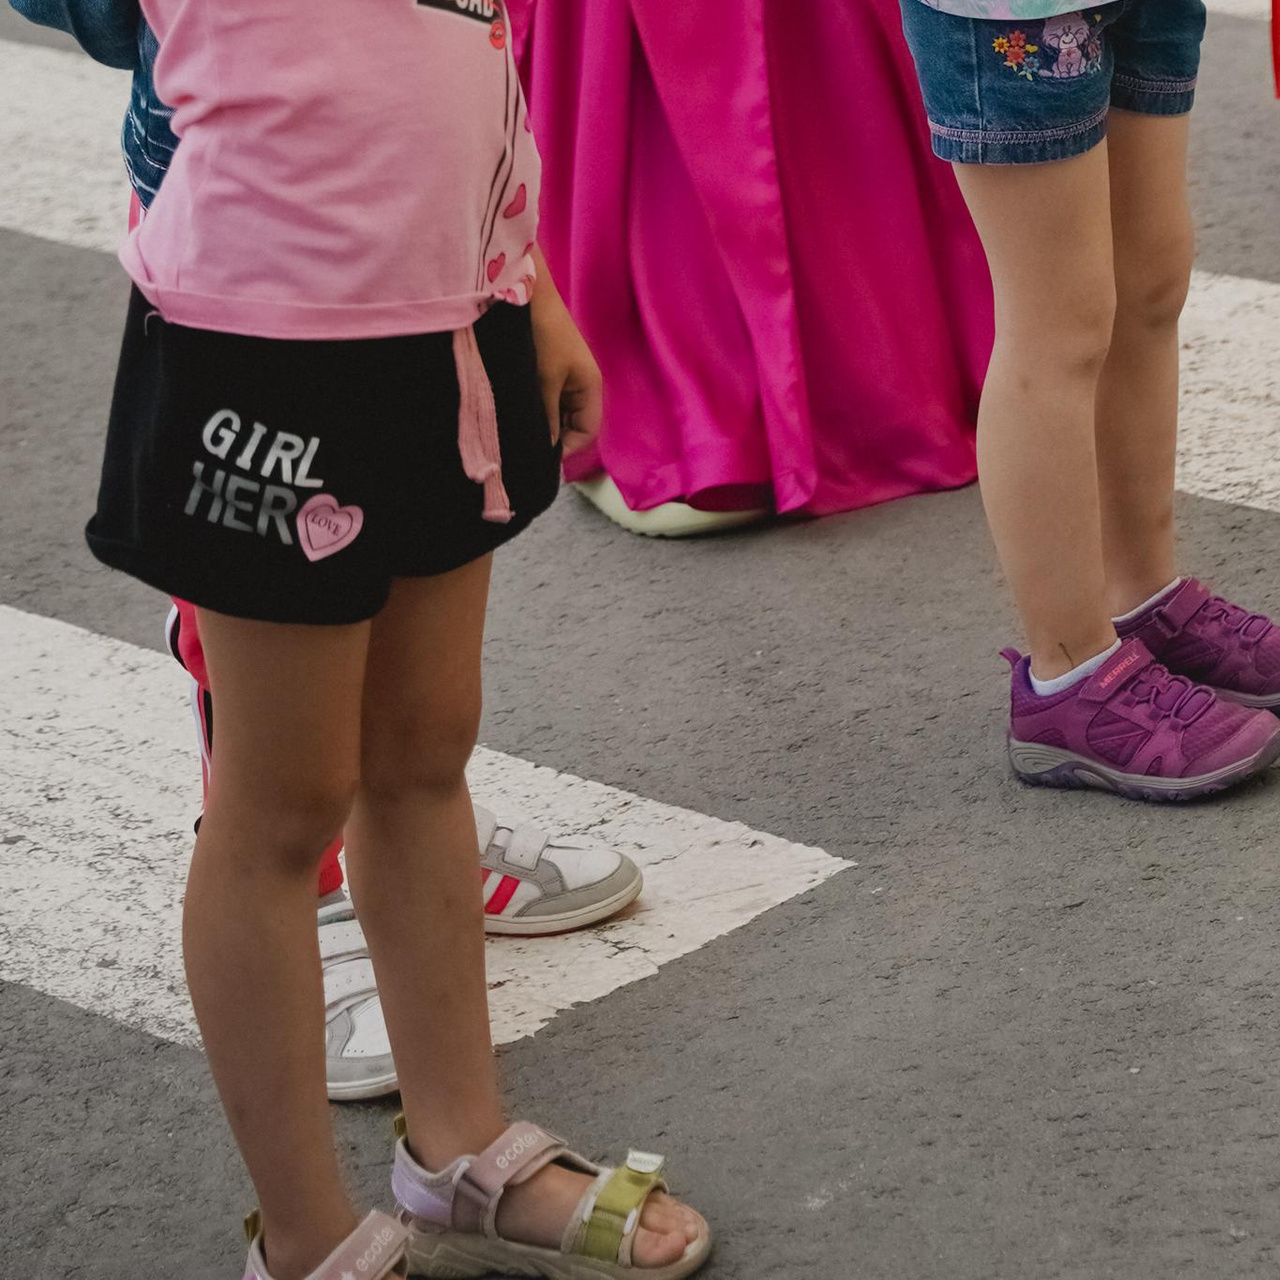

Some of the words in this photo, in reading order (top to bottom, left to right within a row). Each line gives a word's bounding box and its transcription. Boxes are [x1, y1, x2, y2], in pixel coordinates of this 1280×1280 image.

[202, 408, 325, 488] GIRL
[310, 513, 342, 537] LOVE
[1099, 652, 1141, 689] MERRELL
